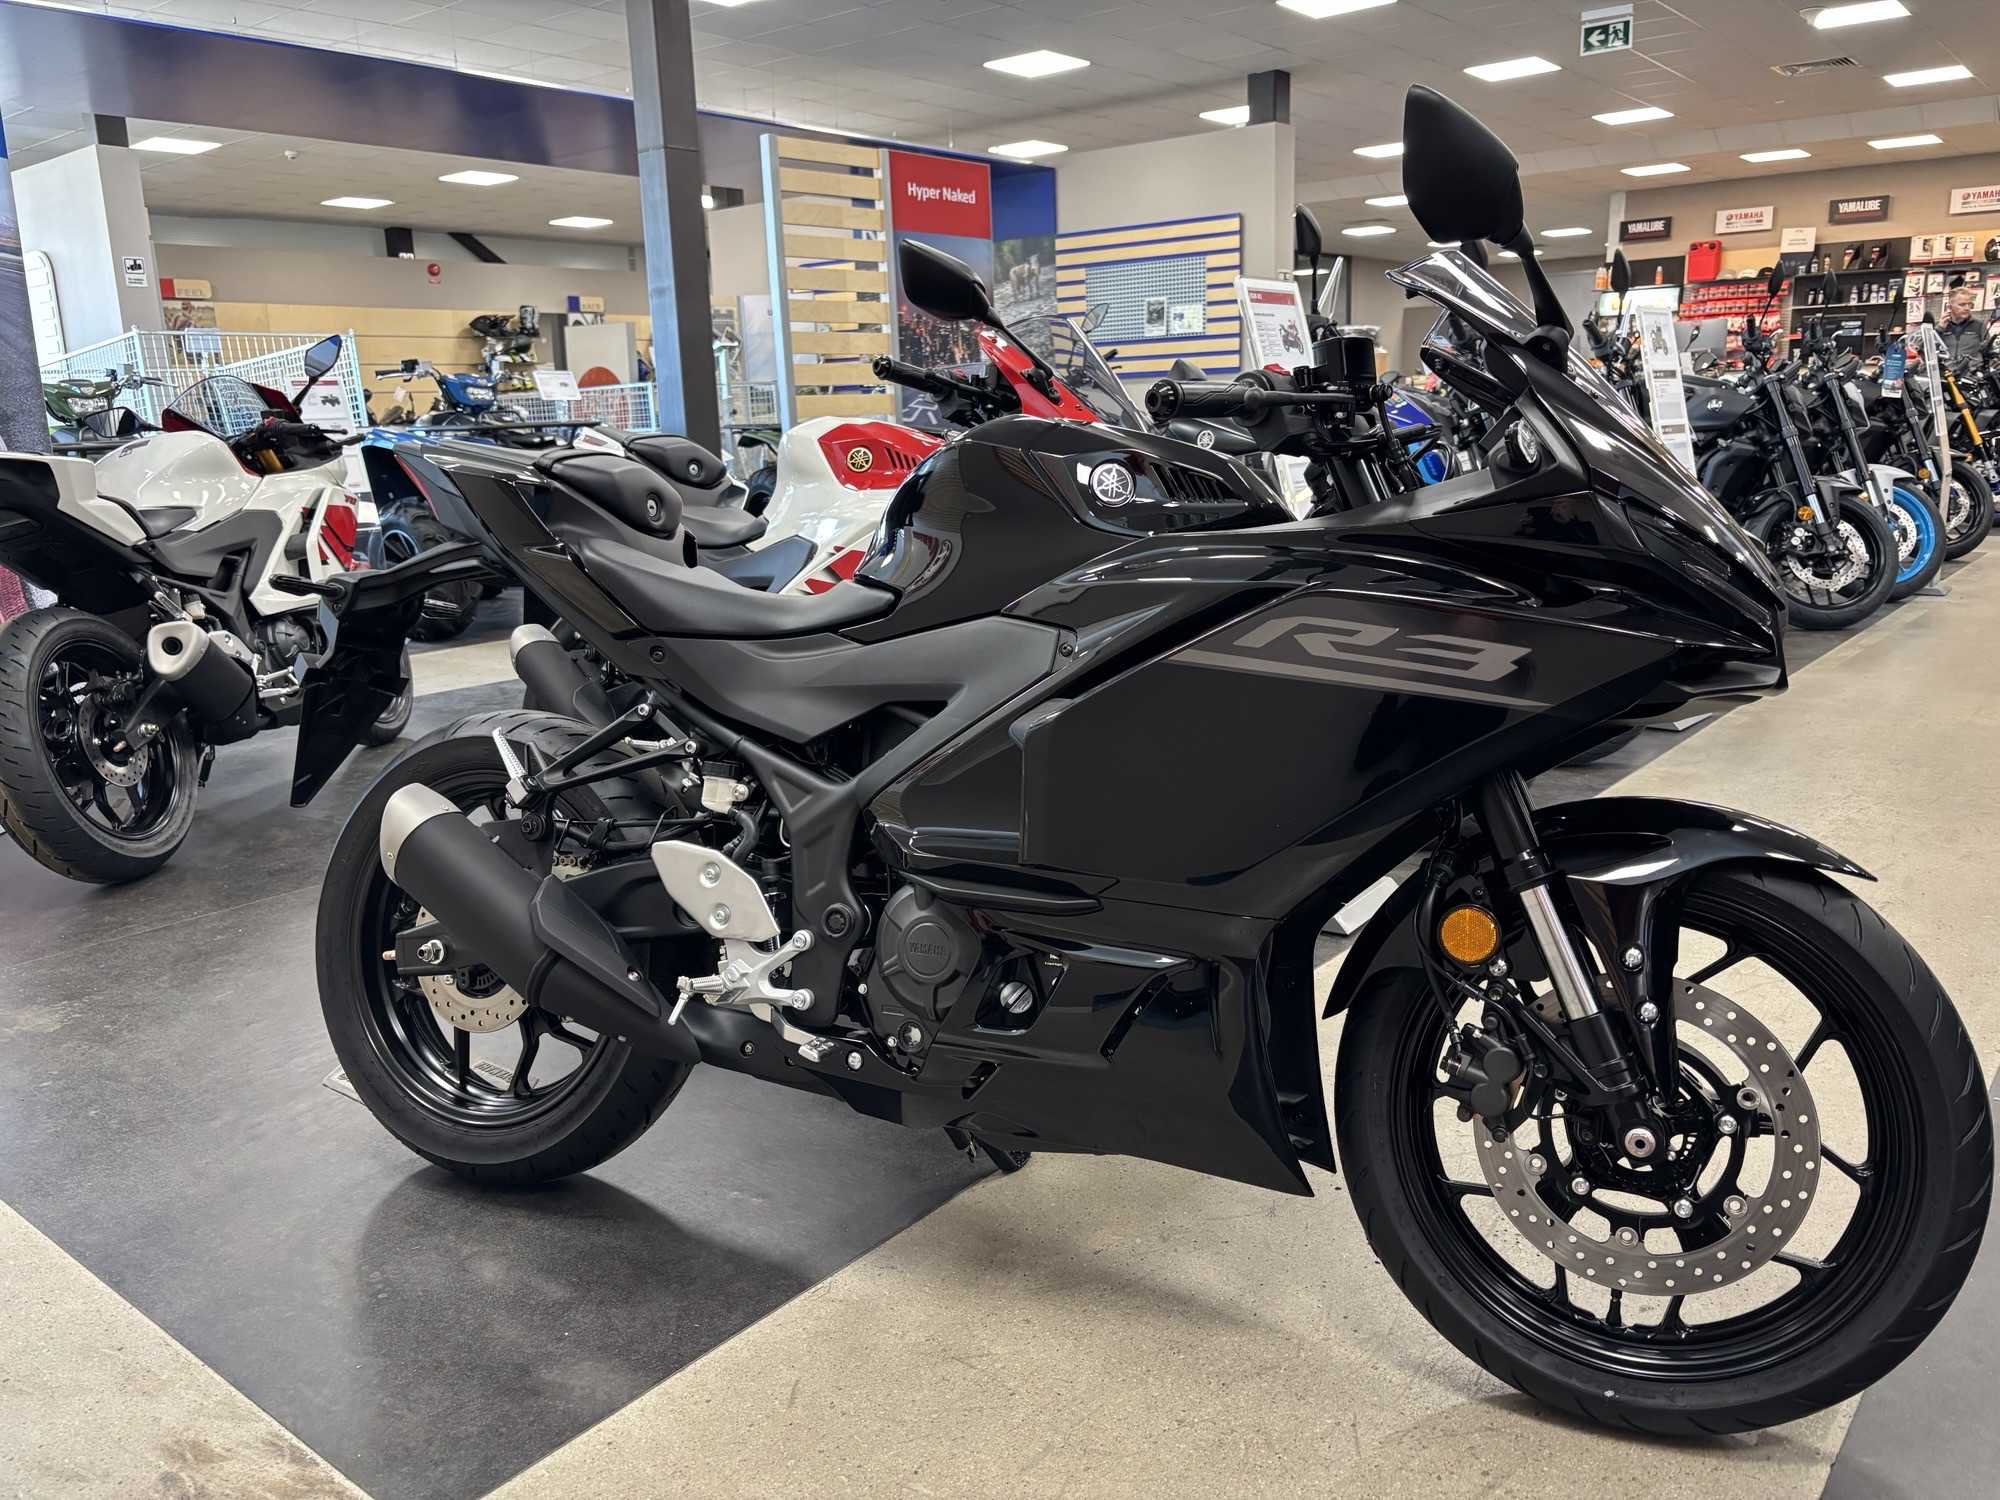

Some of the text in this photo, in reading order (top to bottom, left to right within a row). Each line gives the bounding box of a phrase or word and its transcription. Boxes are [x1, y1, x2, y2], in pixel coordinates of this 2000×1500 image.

[907, 182, 976, 204] Hyper Naked
[1838, 200, 1881, 213] YAMALUBE
[1734, 211, 1764, 221] YAMAHA
[1627, 220, 1665, 234] YAMALUBE
[176, 289, 207, 297] FEEL
[1233, 616, 1532, 682] R3
[909, 942, 947, 956] YAMAHA
